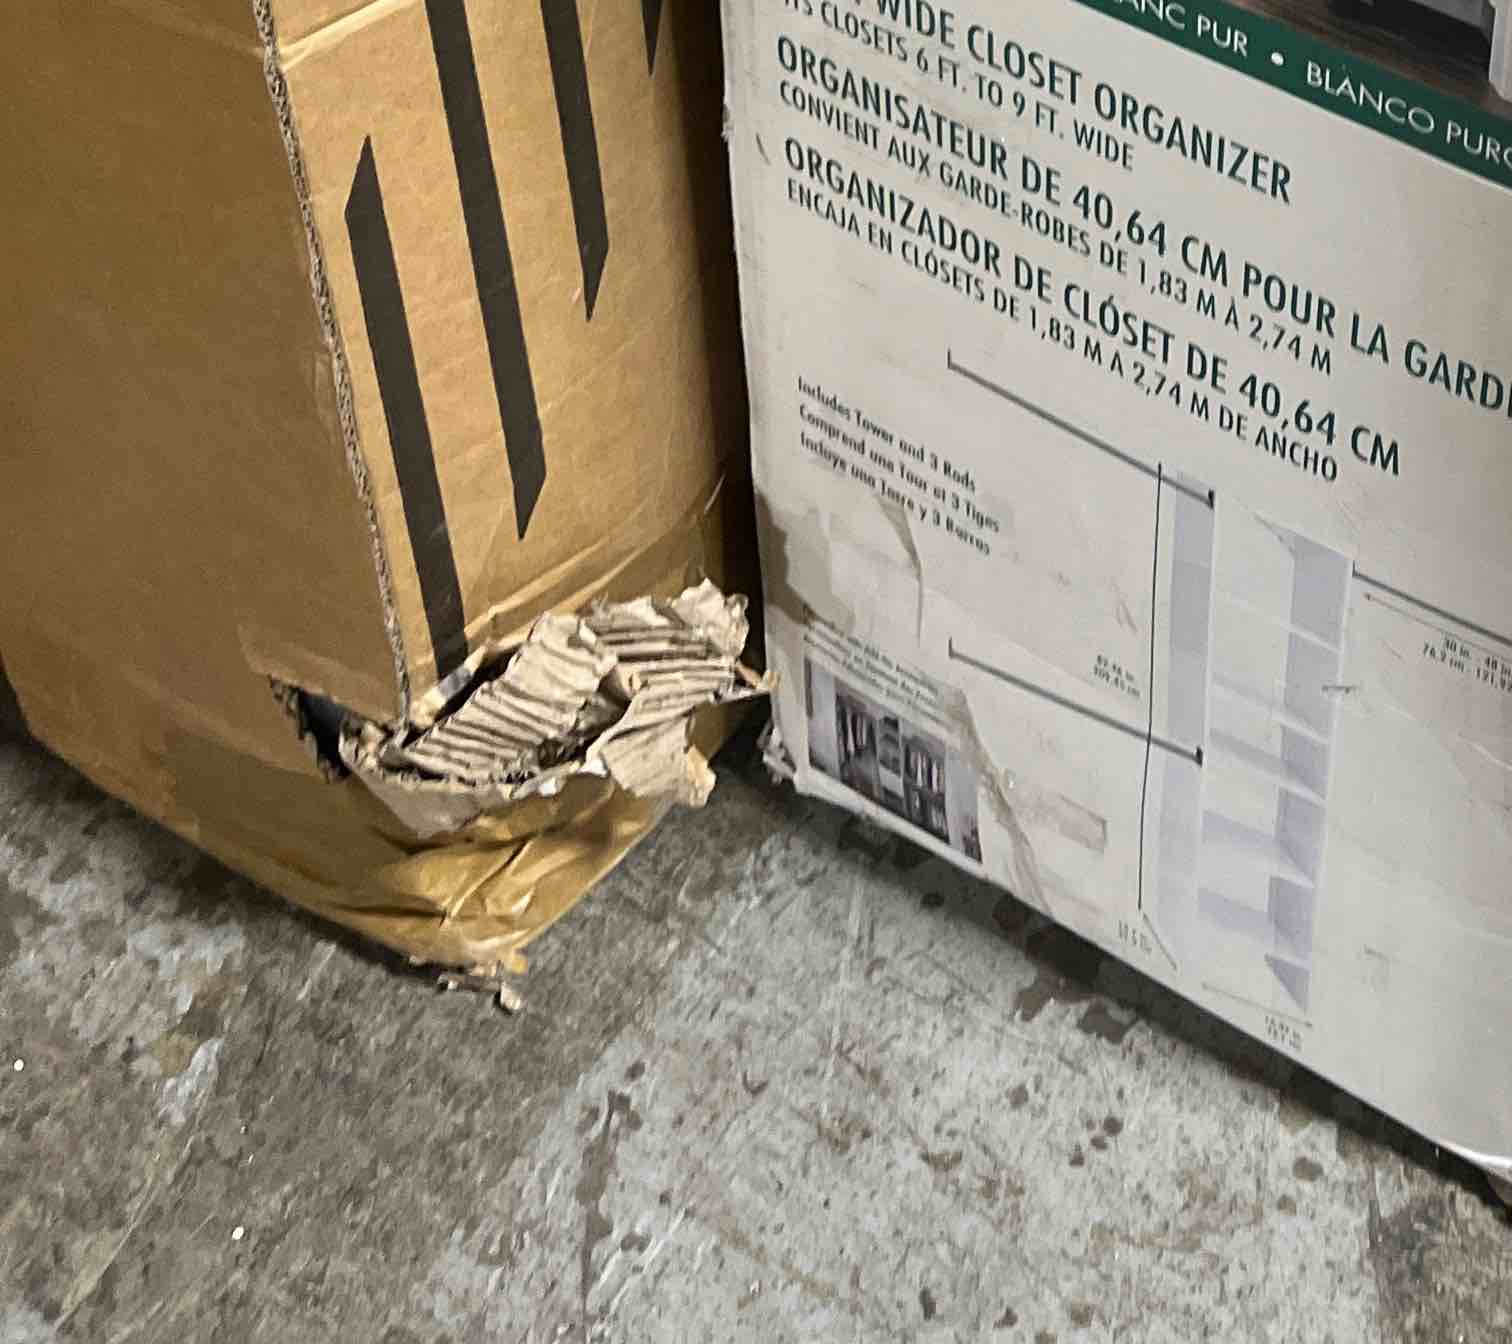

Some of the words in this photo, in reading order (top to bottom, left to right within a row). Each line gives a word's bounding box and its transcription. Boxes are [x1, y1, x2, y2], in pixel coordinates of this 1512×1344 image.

[820, 0, 909, 64] CLOSETS
[916, 47, 929, 74] 6
[937, 59, 968, 94] FT.
[977, 73, 1003, 108] TO
[1012, 91, 1027, 118] 9
[1035, 103, 1065, 140] FT.
[1073, 119, 1136, 173] WIDE
[966, 23, 1083, 106] CLOSET
[1095, 84, 1292, 205] ORGANIZER
[1197, 14, 1249, 58] PUR
[1305, 62, 1436, 136] BLANCO
[777, 34, 1009, 181] ORGANISATEUR
[1021, 154, 1063, 207] DE
[1072, 184, 1166, 257] 40,64
[1181, 235, 1229, 288] CM
[1243, 261, 1338, 339] POUR
[1350, 311, 1390, 365] LA
[779, 79, 880, 150] CONVIENT
[887, 135, 932, 178] AUX
[939, 160, 1092, 258] GARDE-ROBES
[1099, 239, 1129, 276] DE
[1139, 257, 1188, 305] 1,83
[1196, 287, 1216, 321] M
[1248, 313, 1303, 364] 2,74
[1311, 343, 1333, 376] M
[784, 137, 1002, 279] ORGANIZADOR
[1013, 254, 1053, 305] DE
[1062, 282, 1177, 365] CLÓSET
[1186, 343, 1229, 396] DE
[1238, 372, 1338, 448] 40,64
[1349, 424, 1401, 477] CM
[786, 177, 861, 238] ENCAJA
[867, 224, 893, 256] EN
[900, 240, 985, 303] CLÓSETS
[992, 286, 1020, 322] DE
[1029, 305, 1076, 351] 1,83
[1083, 339, 1103, 367] M
[1110, 351, 1124, 378] A
[1133, 360, 1181, 407] 2,74
[1190, 390, 1210, 423] M
[1219, 404, 1249, 441] DE
[1254, 420, 1338, 483] ANCHO
[798, 375, 851, 423] Includes
[854, 408, 894, 446] Tower
[943, 459, 977, 493] Rods
[799, 403, 866, 457] Comprend
[899, 459, 929, 493] Tour
[964, 497, 1000, 533] Tiges
[800, 431, 847, 470] Incluye
[918, 505, 928, 521] y
